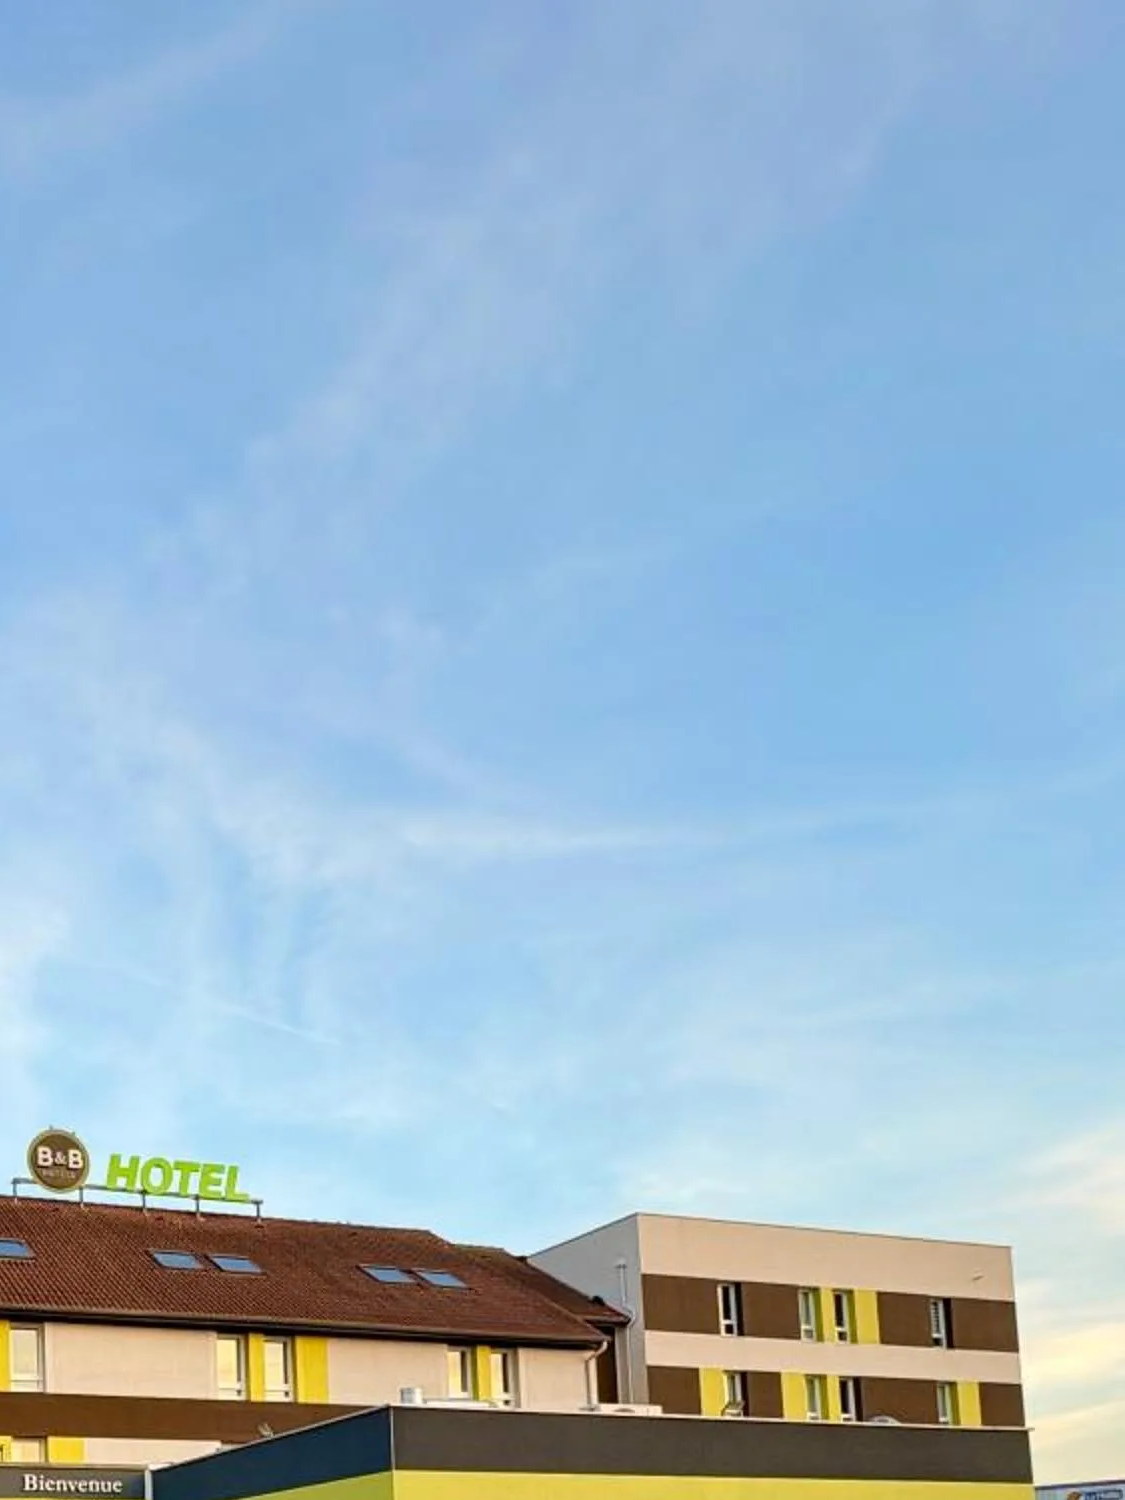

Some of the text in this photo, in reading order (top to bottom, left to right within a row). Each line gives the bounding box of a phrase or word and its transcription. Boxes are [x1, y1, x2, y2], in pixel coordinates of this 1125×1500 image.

[37, 1145, 84, 1169] B&B
[106, 1152, 250, 1201] HOTEL
[23, 1474, 123, 1493] Bienvenue
